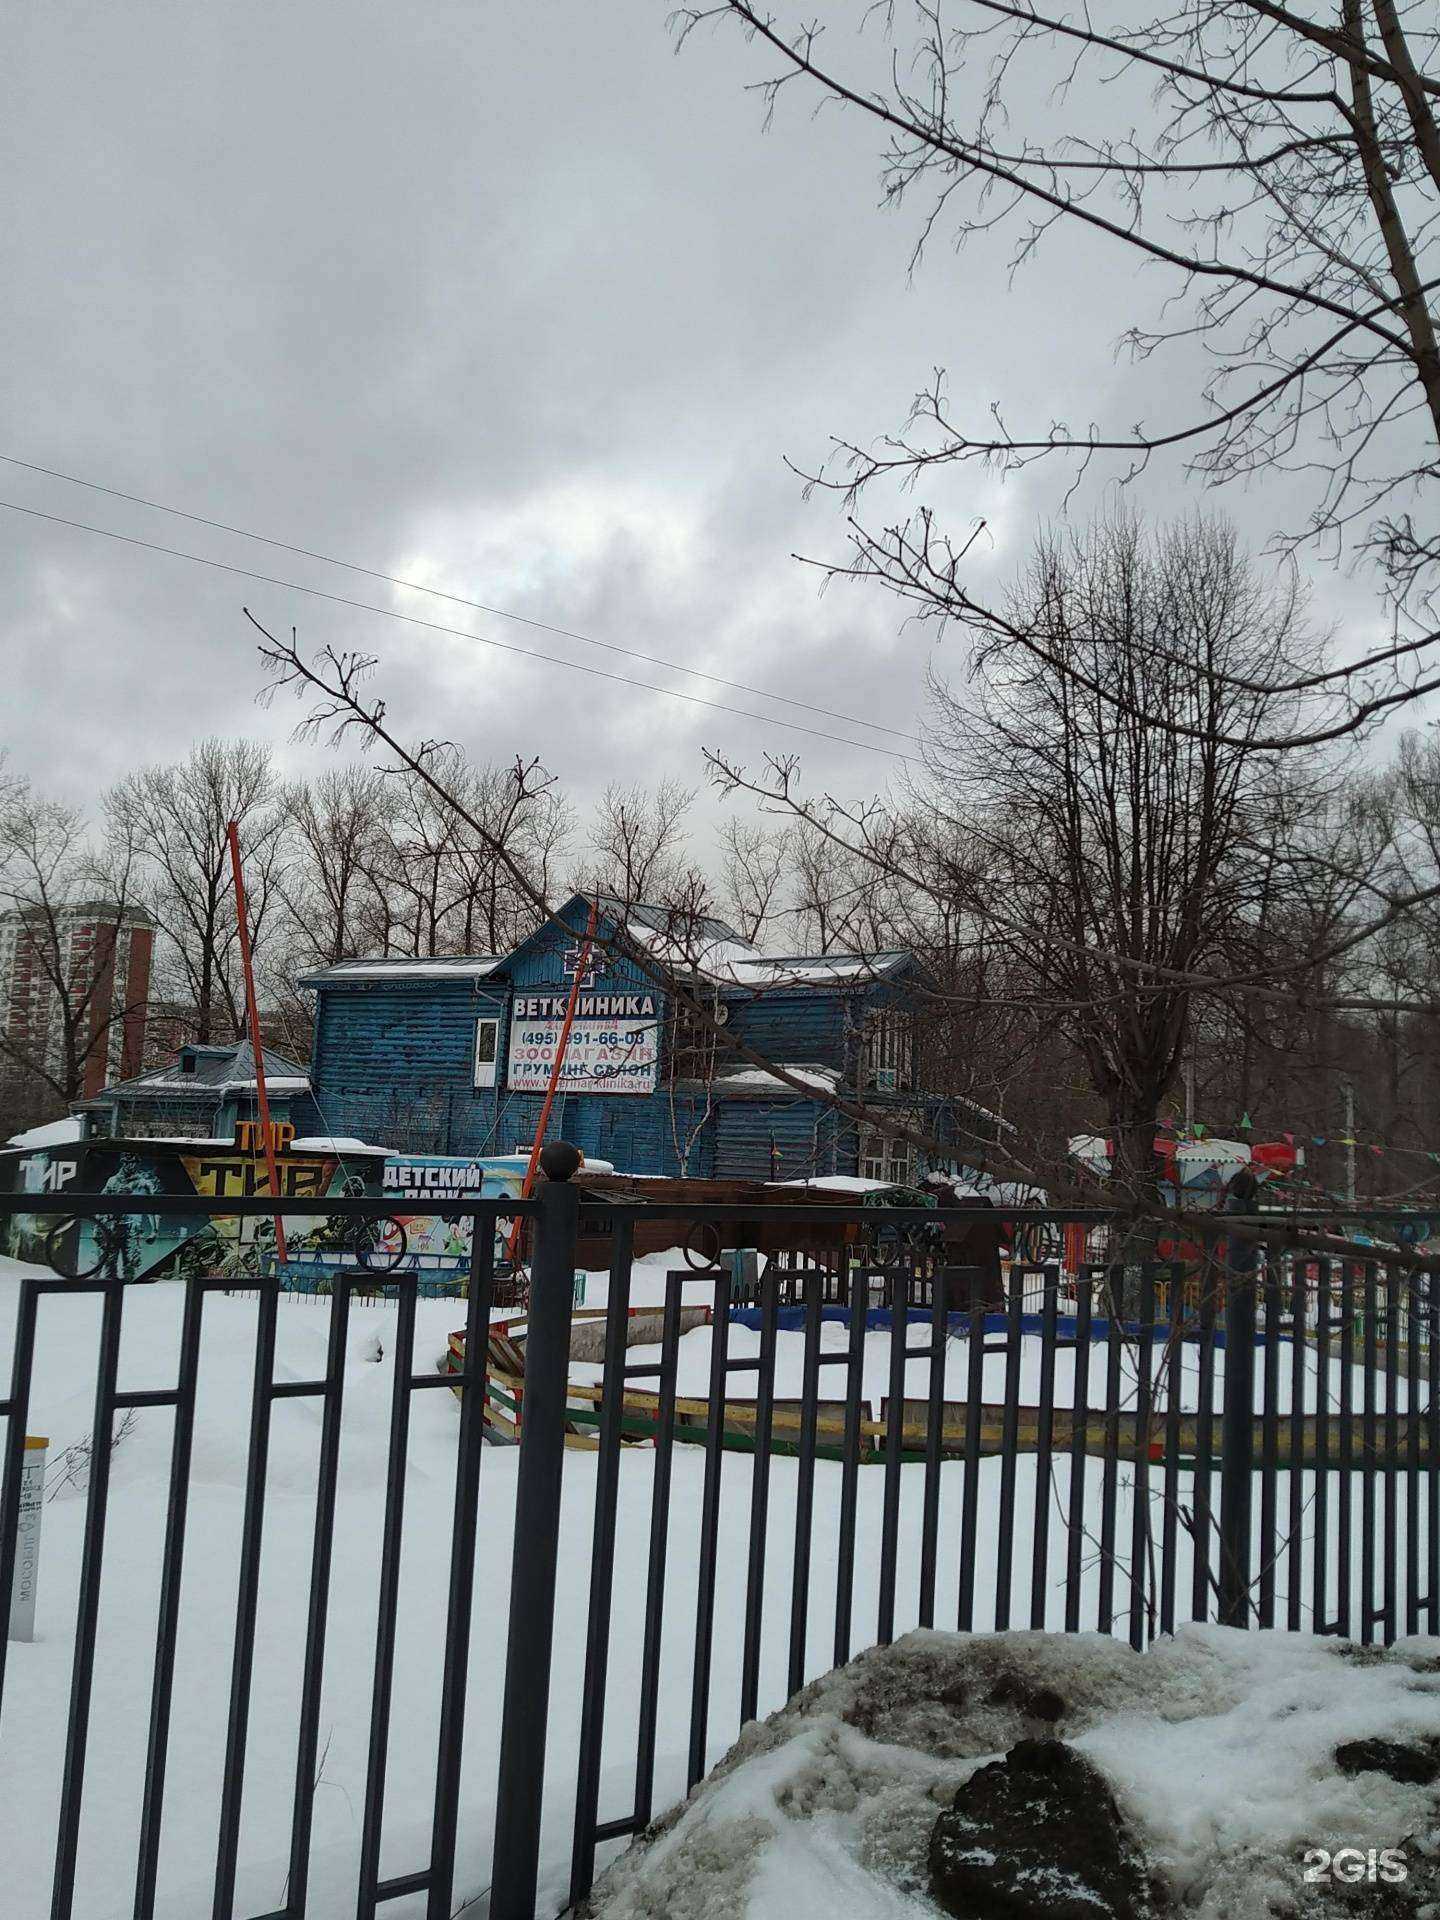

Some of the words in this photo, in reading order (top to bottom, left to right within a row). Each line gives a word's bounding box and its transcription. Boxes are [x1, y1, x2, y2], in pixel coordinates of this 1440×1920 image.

[522, 1032, 557, 1046] (495)
[235, 1120, 296, 1151] ТИР
[18, 1160, 78, 1191] ТИР
[200, 1163, 323, 1196] ТИР
[382, 1164, 480, 1188] ДЕТСКИЙ
